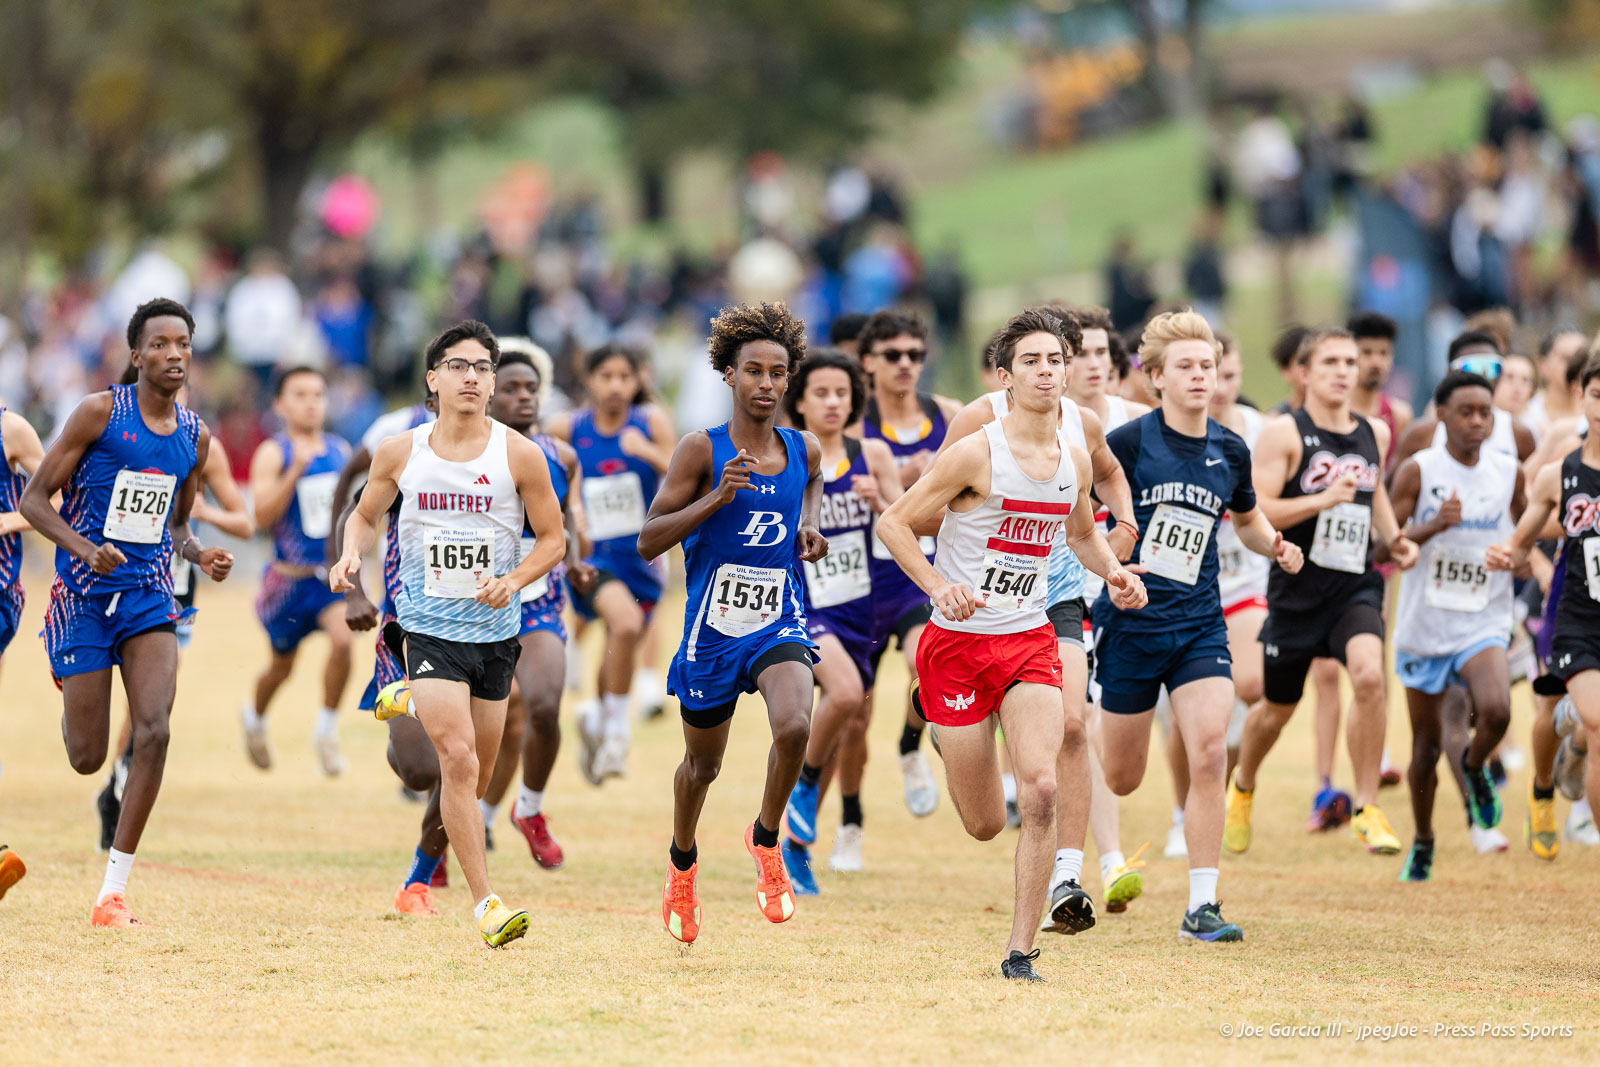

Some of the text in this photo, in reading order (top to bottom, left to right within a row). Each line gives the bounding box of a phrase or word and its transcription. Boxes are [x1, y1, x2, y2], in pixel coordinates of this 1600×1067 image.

[116, 488, 168, 515] 1526
[418, 492, 493, 513] MONTEREY
[820, 491, 871, 529] RGES
[1139, 482, 1222, 516] LONE STAR
[1151, 520, 1204, 555] 1619
[430, 544, 491, 570] 1654
[813, 549, 863, 579] 1592
[1434, 559, 1487, 585] 1555
[737, 574, 777, 583] Championship
[980, 567, 1038, 597] 1540
[717, 579, 779, 612] 1534
